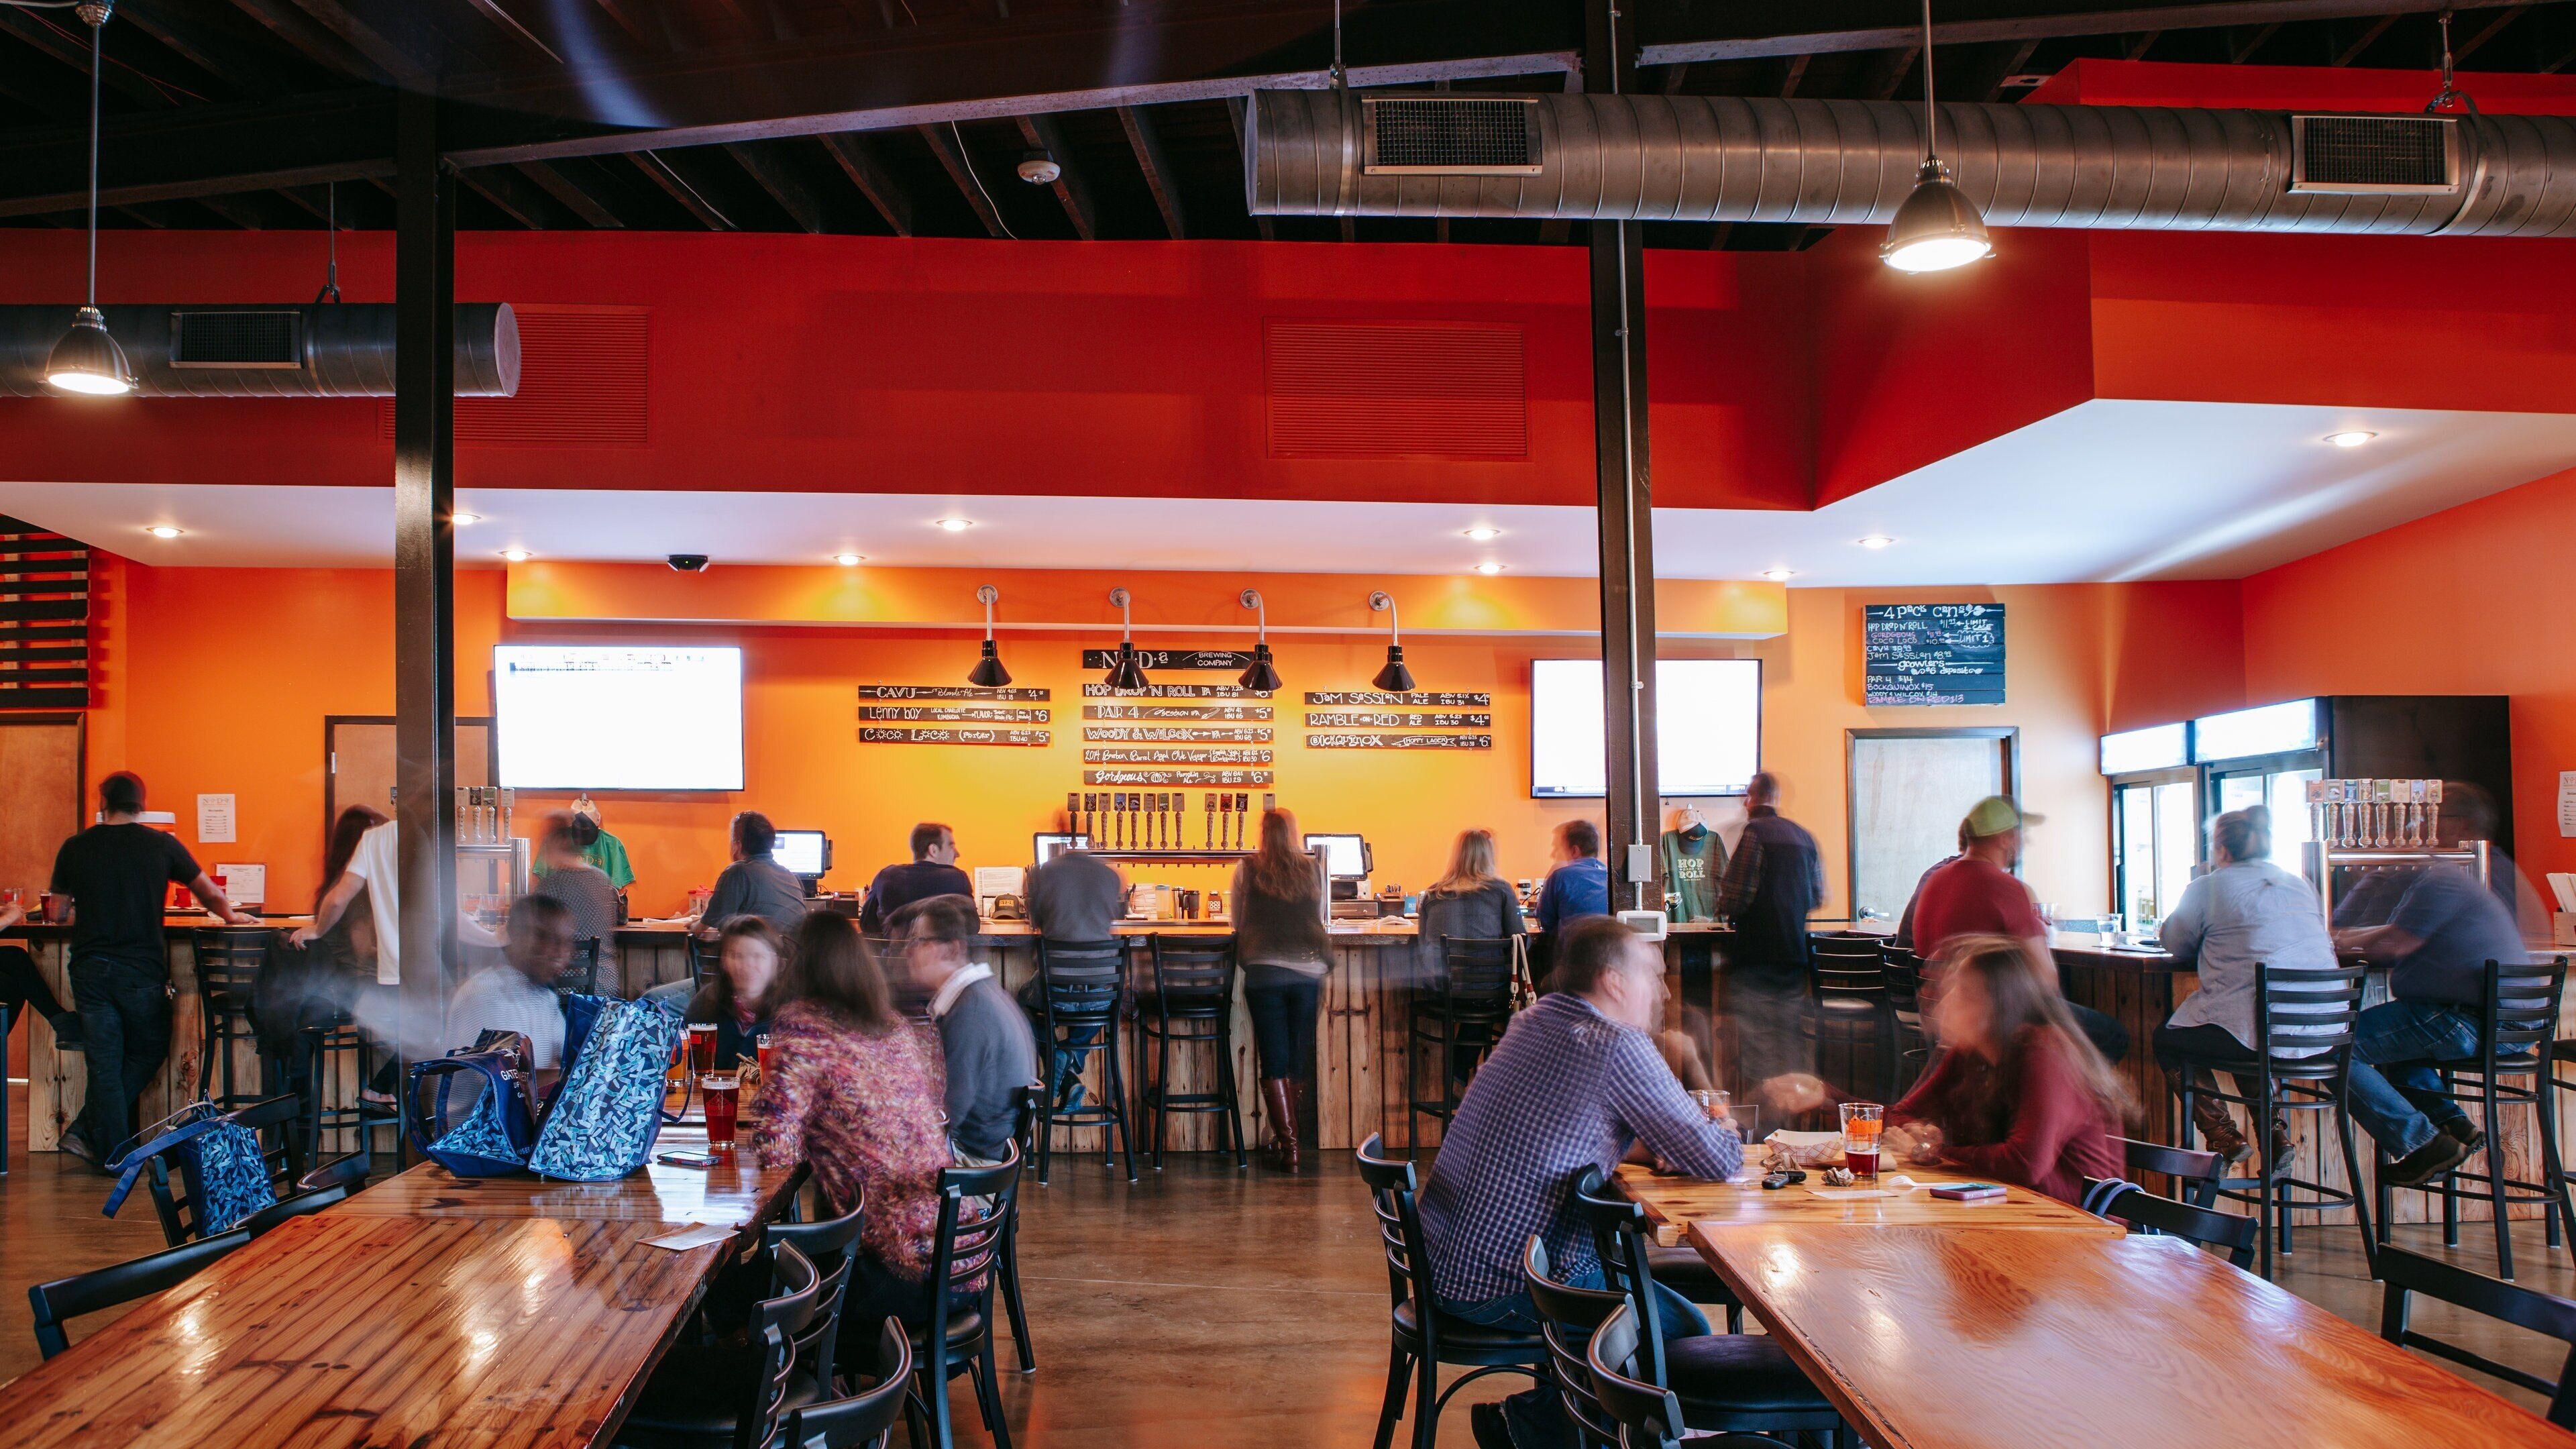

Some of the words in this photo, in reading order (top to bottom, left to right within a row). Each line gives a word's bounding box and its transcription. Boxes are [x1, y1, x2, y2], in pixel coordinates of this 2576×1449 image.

[1884, 606, 1894, 619] 4
[1908, 621, 1927, 630] ROLL
[1960, 634, 1982, 643] LIMIT
[1982, 634, 1988, 642] 1
[1898, 675, 1913, 683] $14
[1085, 684, 1112, 696] HOP
[1115, 686, 1146, 696] DROP
[1167, 686, 1195, 697] ROLL
[1201, 687, 1211, 696] IPA
[1921, 682, 1934, 690] $15
[877, 687, 917, 698] CAVU
[933, 688, 961, 696] Blonde
[961, 688, 973, 697] Ale
[1034, 710, 1047, 721] $6
[1097, 706, 1123, 718] PAR
[1128, 706, 1139, 718] 4
[1310, 714, 1359, 725] RAMBLE
[1373, 714, 1399, 726] RED
[1132, 727, 1143, 739] &
[1212, 731, 1220, 739] IPA
[1085, 750, 1100, 761] 2014
[1130, 750, 1150, 761] Barrel
[1154, 750, 1169, 761] Aged
[1171, 750, 1187, 761] Olde
[1095, 770, 1146, 784] Gordgeous
[1678, 859, 1704, 867] HOP
[1679, 870, 1705, 878] ROLL
